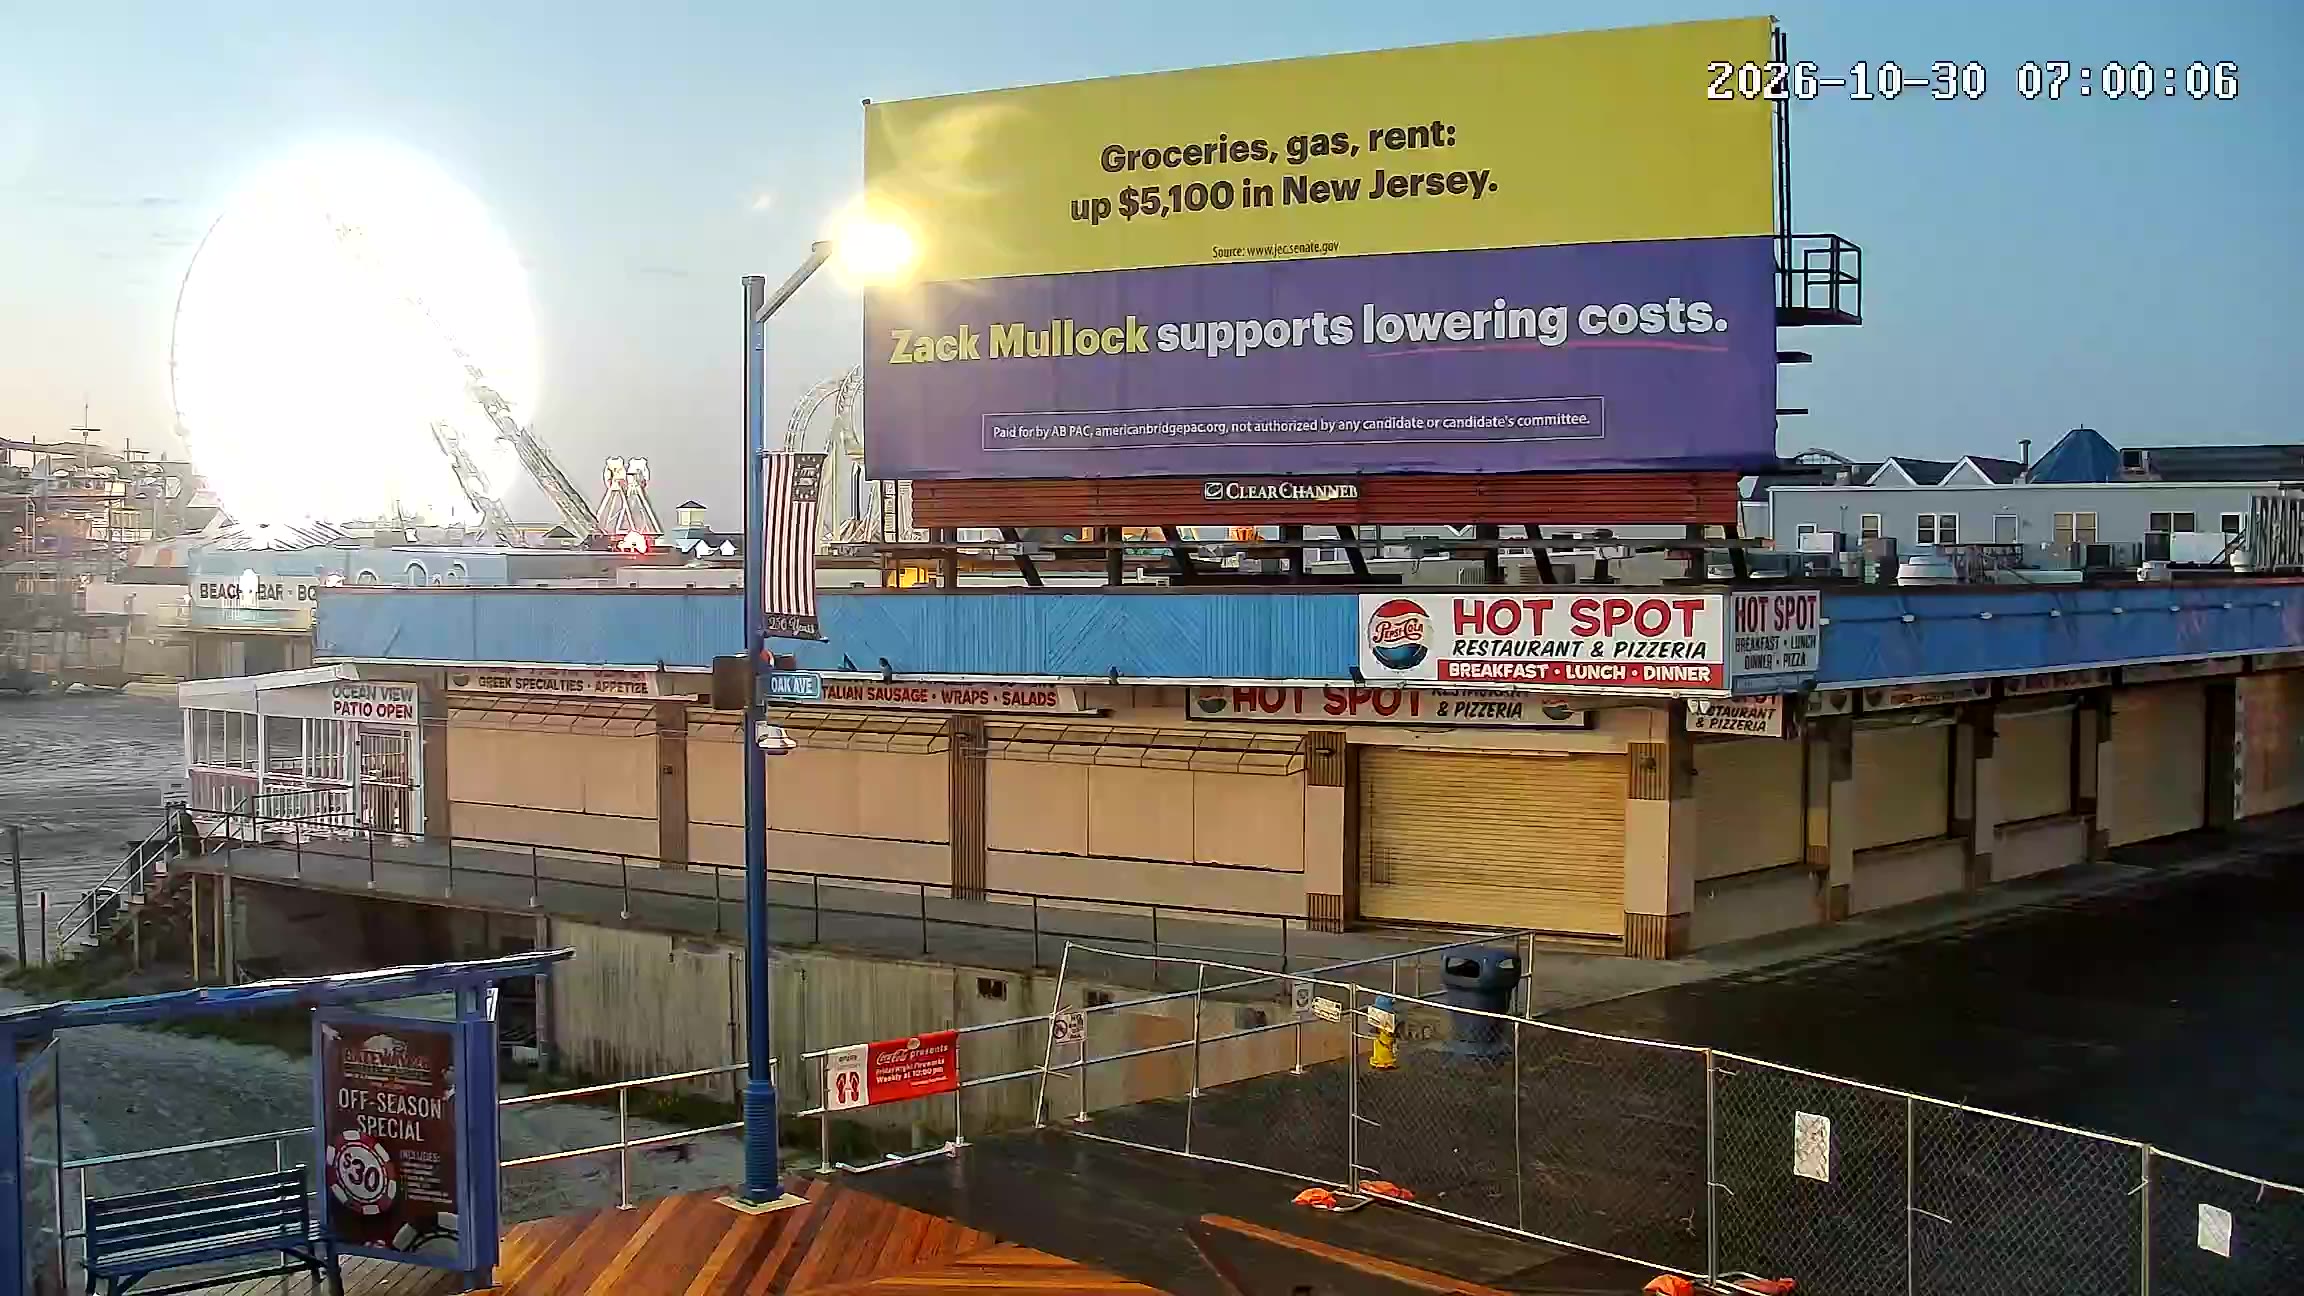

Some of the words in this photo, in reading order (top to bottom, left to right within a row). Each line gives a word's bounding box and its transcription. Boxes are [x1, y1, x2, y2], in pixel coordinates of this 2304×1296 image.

[1101, 134, 1278, 173] Groceries,
[1286, 131, 1360, 165] gas,
[1369, 120, 1456, 151] rent:
[1070, 197, 1111, 226] up
[1118, 180, 1235, 221] $5,100
[1242, 178, 1274, 208] in
[1282, 175, 1362, 205] New
[1369, 168, 1498, 200] Jersey.
[1212, 246, 1245, 258] Source:
[1246, 240, 1339, 258] www.jec.senate.gov
[889, 324, 980, 364] Zack
[988, 315, 1150, 360] Mullock
[1156, 312, 1354, 358] supports
[1363, 298, 1568, 346] lowering
[1577, 297, 1728, 335] costs.
[993, 426, 1017, 438] Paid
[1018, 425, 1034, 438] for
[1035, 425, 1050, 440] by
[1051, 425, 1067, 437] AB
[1069, 424, 1093, 438] PAC,
[1095, 421, 1229, 437] americanbridgepac.org,
[1231, 421, 1251, 433] not
[1254, 418, 1318, 433] authorized
[1321, 420, 1336, 434] by
[1338, 420, 1360, 433] any
[1363, 416, 1424, 429] candidate
[1426, 419, 1440, 429] or
[1443, 415, 1515, 429] candidate's
[1517, 412, 1590, 427] committee.
[1452, 598, 1553, 636] HOT
[1570, 598, 1705, 638] SPOT
[1735, 596, 1768, 632] HOT
[1773, 595, 1818, 632] SPOT
[1452, 639, 1583, 658] RESTAURANT
[1590, 640, 1605, 658] &
[1613, 640, 1707, 660] PIZZERIA
[1735, 635, 1780, 652] BREAKFAST
[1790, 635, 1817, 650] LUNCH
[1744, 654, 1773, 671] DINNER
[1783, 652, 1806, 667] PIZZA
[1449, 662, 1550, 680] BREAKFAST
[1565, 663, 1627, 681] LUNCH
[1642, 665, 1713, 683] DINNER
[332, 683, 377, 701] OCEAN
[379, 685, 413, 702] VIEW
[478, 676, 512, 689] GREEK
[515, 677, 584, 692] SPECIALTIES
[771, 677, 791, 693] OAK
[792, 677, 813, 694] AVE
[867, 687, 928, 703] SAUSAGE
[941, 688, 989, 706] WRAPS
[1002, 689, 1057, 707] SALADS
[1323, 687, 1420, 717] SPOT
[333, 700, 373, 717] PATIO
[376, 702, 413, 720] OPEN
[1437, 702, 1448, 717] &
[1454, 701, 1524, 720] PIZZERIA
[1709, 717, 1767, 732] PIZZERIA
[338, 1087, 441, 1120] OFF-SEASON
[357, 1113, 425, 1142] SPECIAL
[342, 1152, 380, 1192] $30
